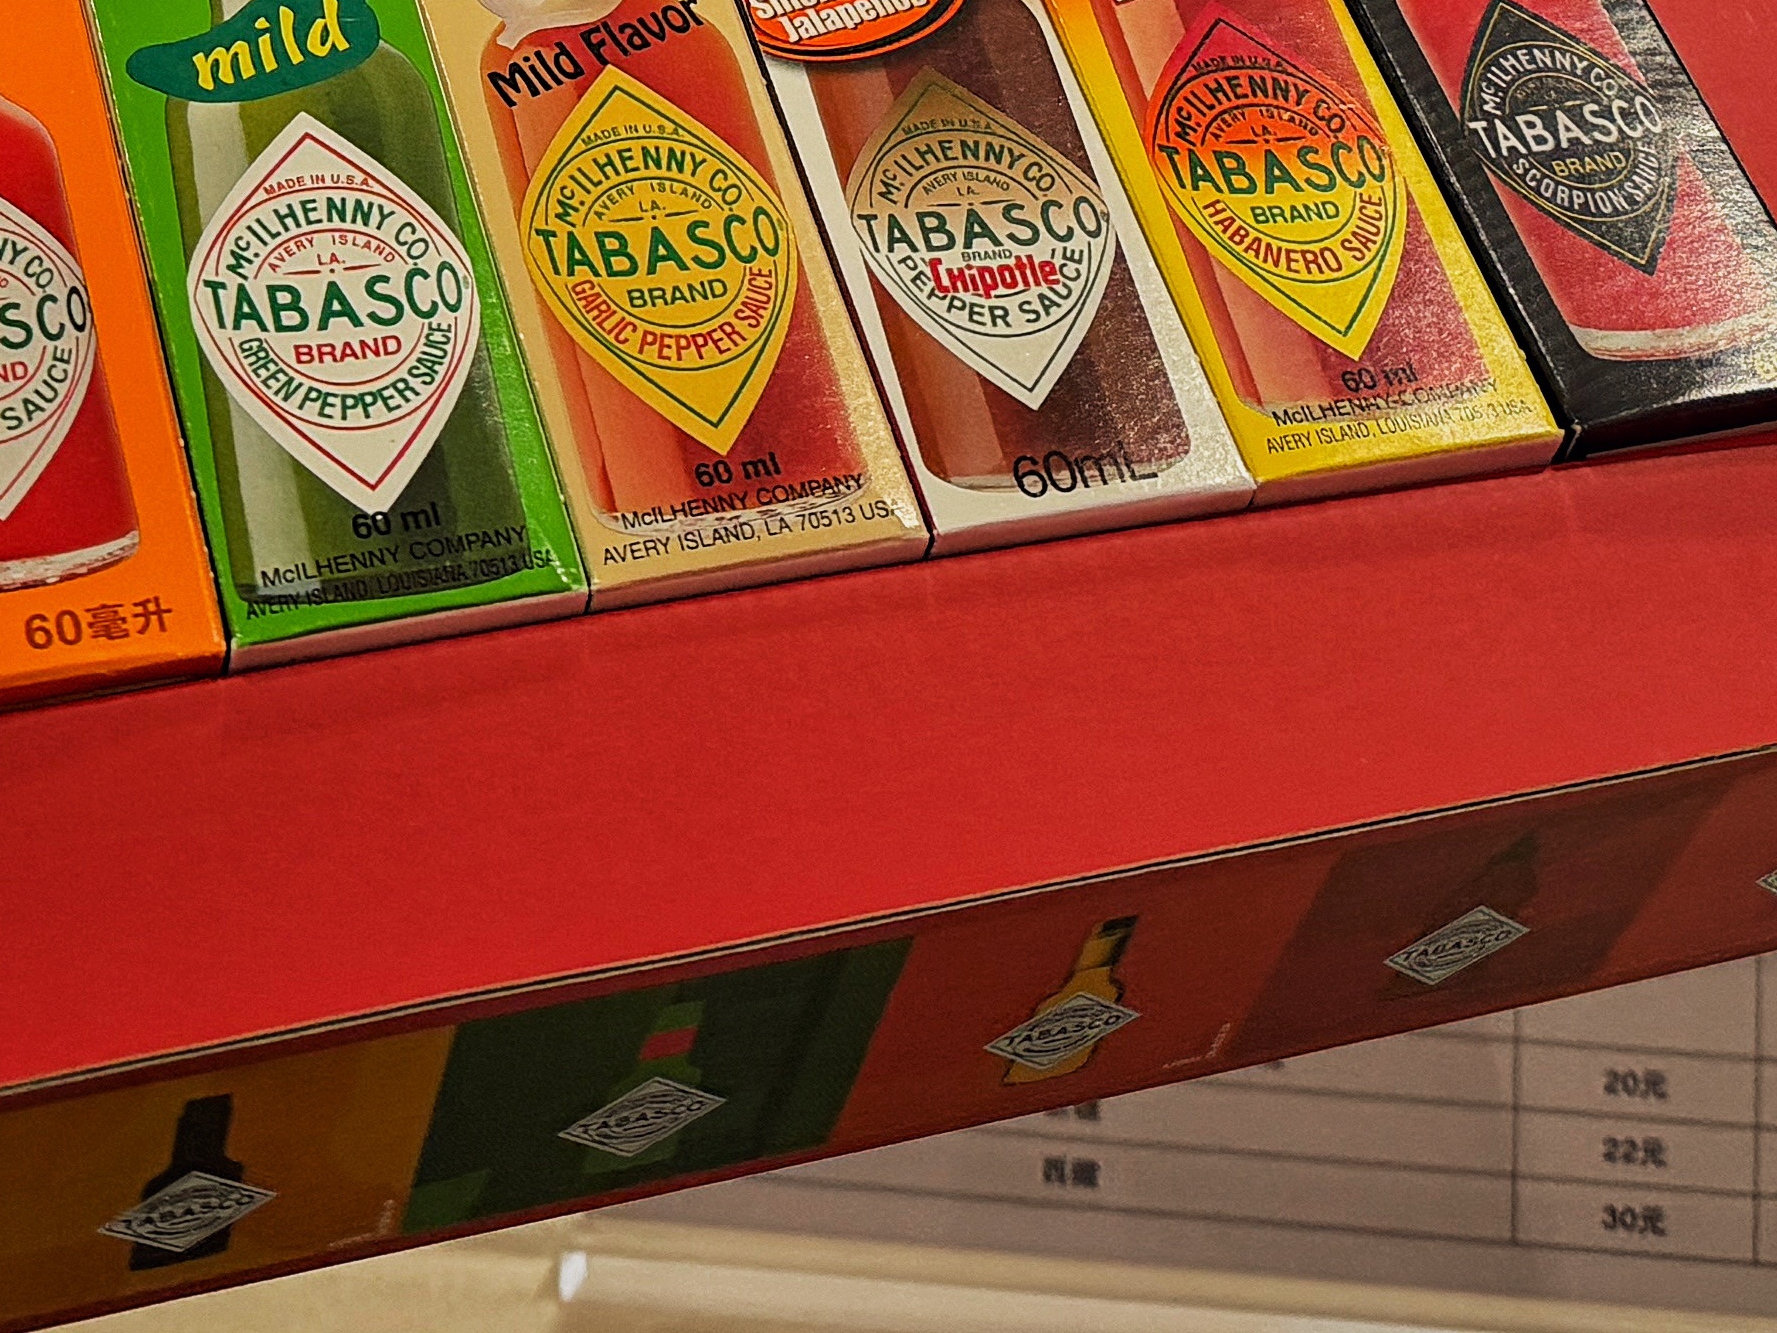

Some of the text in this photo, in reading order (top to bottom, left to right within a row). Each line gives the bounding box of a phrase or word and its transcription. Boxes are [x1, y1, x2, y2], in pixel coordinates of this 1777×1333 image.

[487, 41, 585, 108] Mild
[580, 125, 638, 147] MADE IN
[1468, 95, 1662, 159] TABASCO
[263, 176, 306, 196] MADE
[310, 174, 325, 185] IN
[922, 171, 1011, 196] AVERY ISLAND
[1157, 135, 1386, 195] TABASCO
[1513, 158, 1631, 214] SCORPION
[1552, 151, 1626, 177] BRAND
[593, 182, 712, 221] AVERY ISLAND
[639, 200, 666, 213] LA.
[709, 168, 742, 212] CO.
[857, 196, 1102, 253] TABASCO
[1202, 193, 1382, 275] HABANERO SAUCE
[1250, 200, 1340, 225] BRAND
[267, 235, 396, 273] AVERY ISLAND
[317, 253, 345, 266] LA.
[395, 222, 430, 266] CO.
[534, 205, 780, 278] TABASCO
[961, 248, 1013, 262] BRAND
[23, 255, 55, 293] CO.
[627, 278, 728, 308] BRAND
[897, 245, 1084, 328] PEPPER SAUCE
[928, 254, 1061, 301] Chipotle
[203, 260, 463, 334] TABASCO
[572, 266, 772, 361] GARLIC PEPPER SAUCE
[239, 321, 452, 421] GREEN PEPPER SAUCE
[293, 335, 402, 364] BRAND
[0, 344, 72, 431] SAUCE
[1341, 367, 1377, 393] 60
[1266, 432, 1313, 455] AVERY
[694, 452, 781, 488] 60 ml
[1013, 441, 1158, 500] 60mL
[352, 502, 441, 540] 60 ml
[621, 473, 867, 531] McILHENNY COMPANY
[261, 525, 526, 588] McILHENNY COMPANY
[603, 506, 855, 566] AVERY ISLAND, LA 70513
[23, 596, 173, 650] 60毫升
[246, 593, 301, 620] AVERY
[1006, 1015, 1121, 1047] TABASCO
